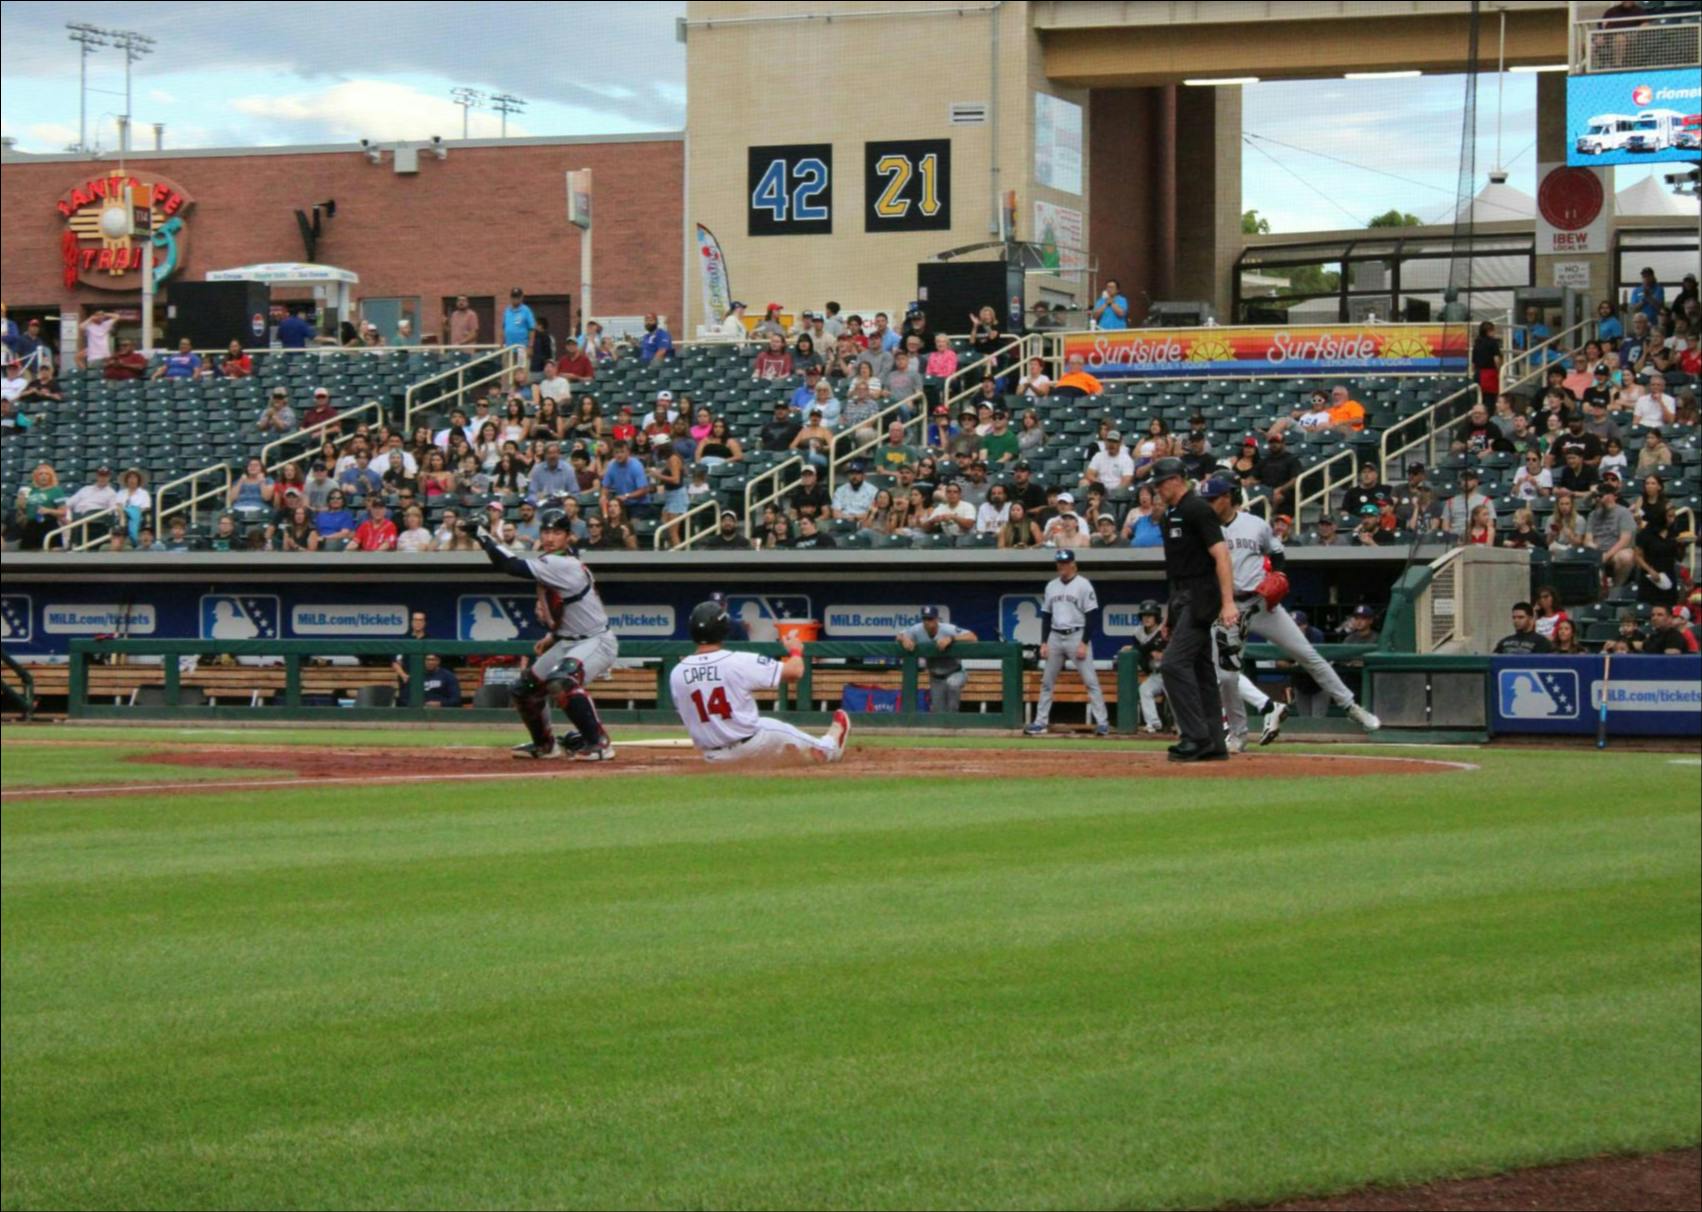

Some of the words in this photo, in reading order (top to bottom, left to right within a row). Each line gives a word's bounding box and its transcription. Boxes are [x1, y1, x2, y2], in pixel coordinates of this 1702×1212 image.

[752, 158, 828, 221] 42
[874, 154, 941, 218] 21
[152, 182, 182, 215] FE
[1553, 232, 1588, 244] IBEW
[80, 246, 158, 270] TRAI
[1564, 265, 1580, 273] NO
[1088, 335, 1181, 368] Surfside
[1267, 332, 1375, 364] Surfside
[298, 613, 403, 626] MiLB.com/tickets
[608, 614, 669, 628] m/tickets
[830, 614, 922, 628] MiLB.com/tick
[683, 666, 721, 684] CAPEL
[691, 686, 732, 722] 14
